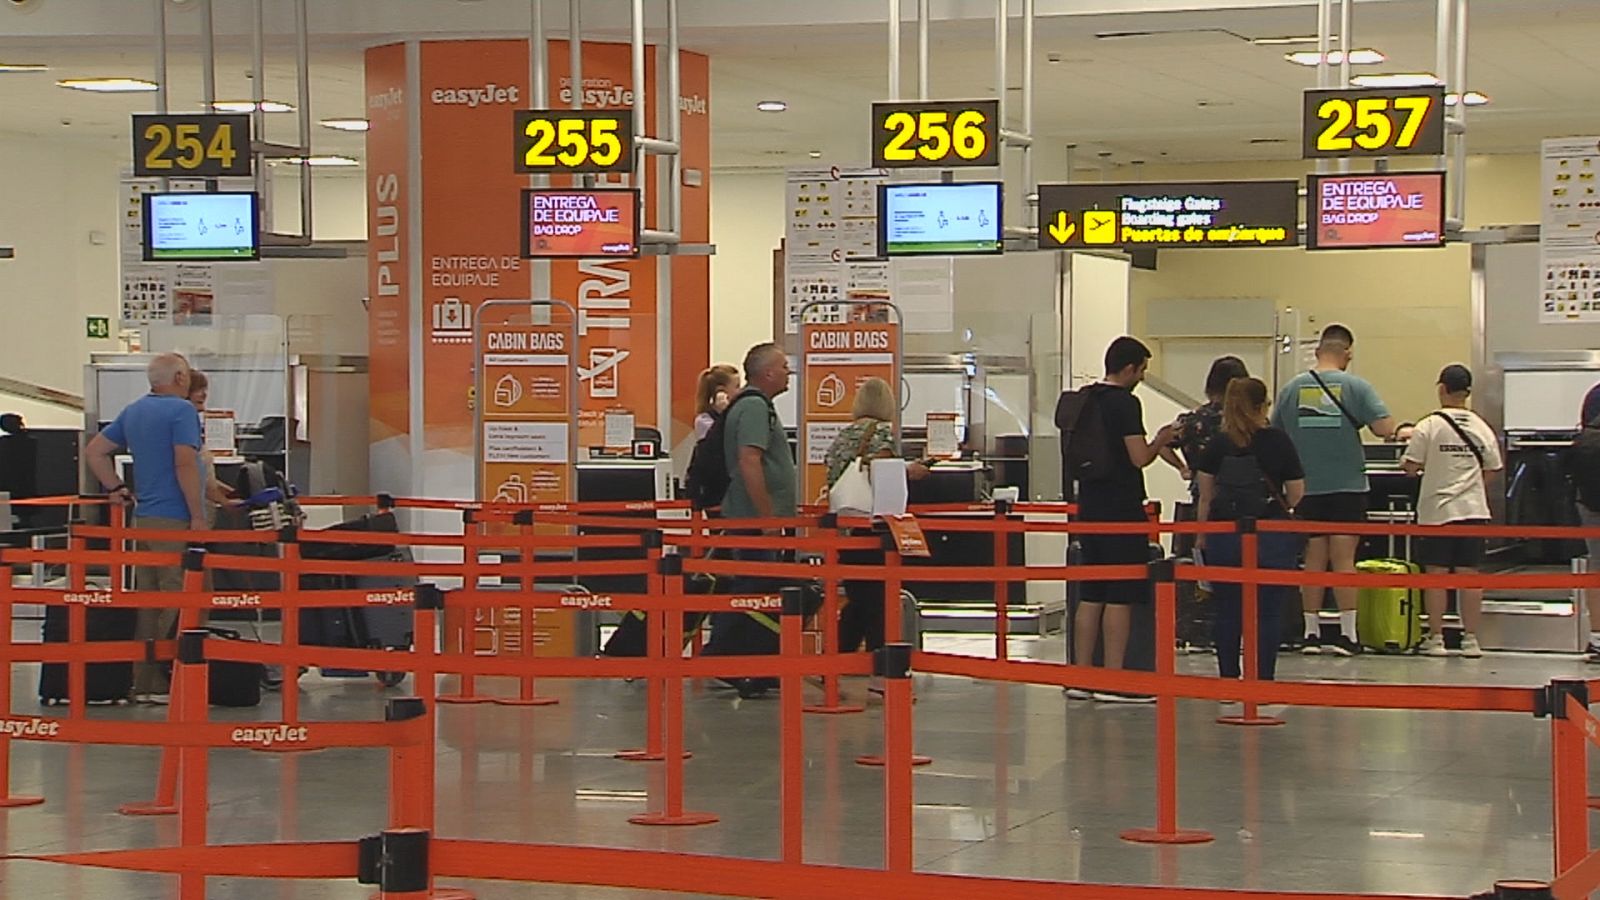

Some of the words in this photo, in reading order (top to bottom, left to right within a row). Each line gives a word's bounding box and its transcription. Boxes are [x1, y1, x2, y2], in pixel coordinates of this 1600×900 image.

[431, 84, 519, 108] easyJet
[1316, 96, 1432, 152] 257
[524, 118, 622, 167] 255
[883, 110, 987, 161] 256
[144, 123, 236, 170] 254
[1322, 181, 1398, 197] ENTREGA
[533, 195, 597, 209] ENTREGA
[1322, 197, 1345, 211] DE
[1347, 194, 1424, 210] EQUIPAJE
[533, 209, 553, 222] DE
[555, 209, 619, 222] EQUIPAJE
[1322, 214, 1345, 224] BAG
[1347, 213, 1379, 224] DROP
[375, 173, 401, 297] PLUS
[533, 224, 554, 236] BAG
[555, 224, 582, 236] DROP
[1121, 226, 1181, 242] Puertas
[1183, 226, 1204, 242] de
[1207, 226, 1286, 244] embarque
[431, 257, 498, 270] ENTREGA
[501, 257, 521, 270] DE
[431, 273, 500, 287] EQUIPAJE
[487, 332, 527, 350] CABIN
[530, 332, 565, 350] BAGS
[810, 331, 850, 349] CABIN
[854, 331, 889, 349] BAGS
[63, 591, 112, 605] easyJet
[212, 593, 261, 607] easyJet
[367, 590, 415, 604] easyJet
[560, 595, 612, 608] easyJet
[231, 724, 308, 742] easyJet
